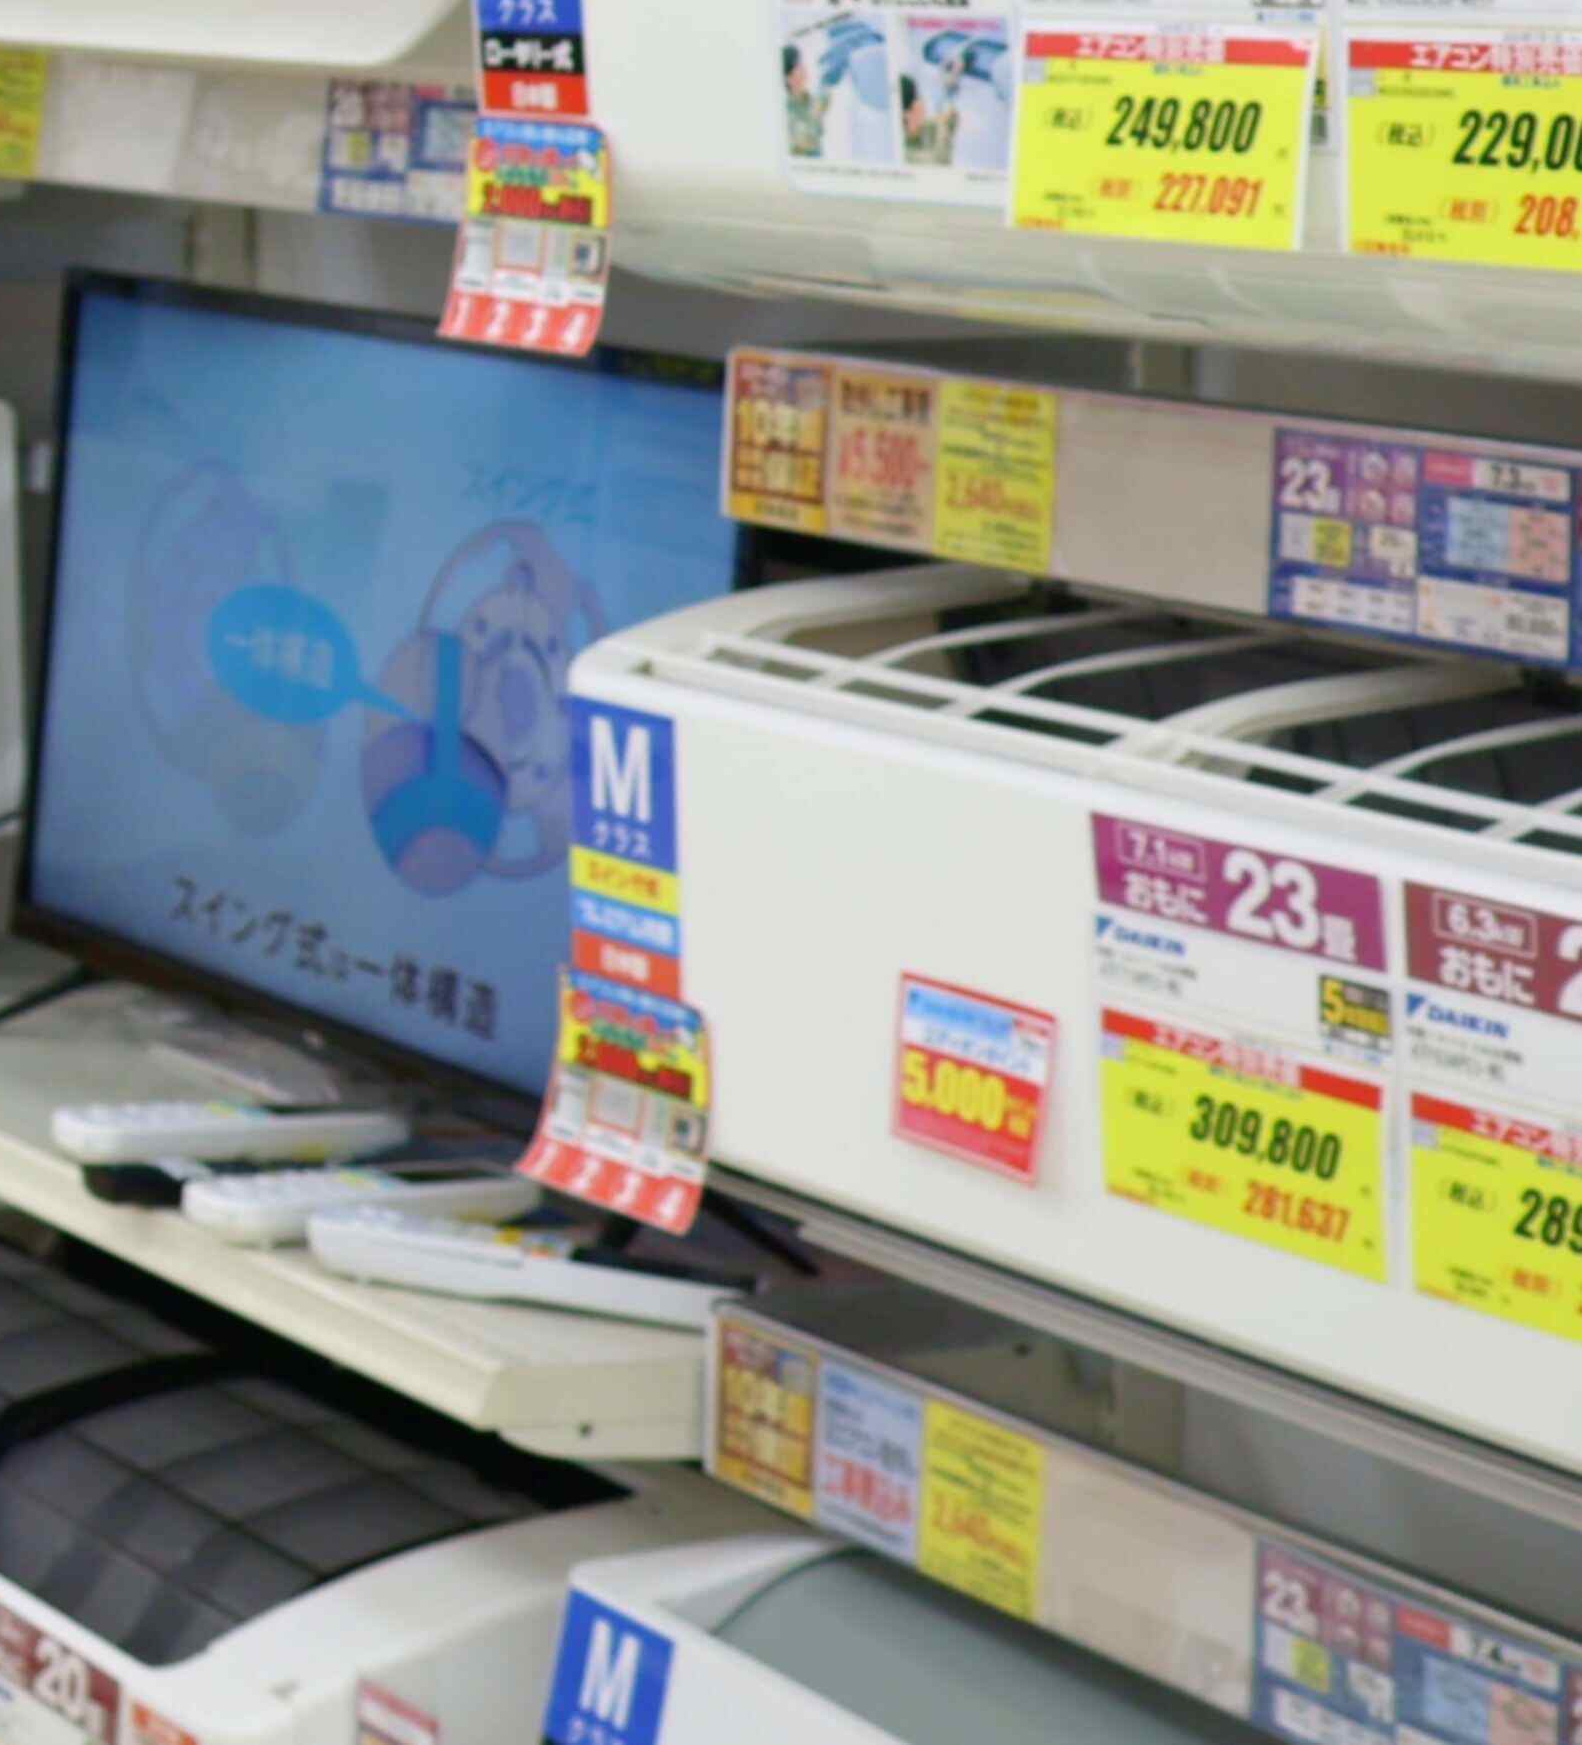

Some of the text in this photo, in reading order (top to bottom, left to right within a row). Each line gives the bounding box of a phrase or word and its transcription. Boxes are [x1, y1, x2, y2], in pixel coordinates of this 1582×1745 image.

[1106, 96, 1263, 154] 249,800
[590, 716, 649, 822] M
[593, 823, 650, 857] クラス
[1123, 874, 1207, 924] おもに
[1116, 923, 1186, 956] DAIKIN
[1438, 947, 1535, 1005] おもに
[1428, 1003, 1510, 1041] DAIKIN
[1190, 1093, 1340, 1180] 309,800
[1242, 1180, 1351, 1241] 281,637
[578, 1618, 640, 1732] M
